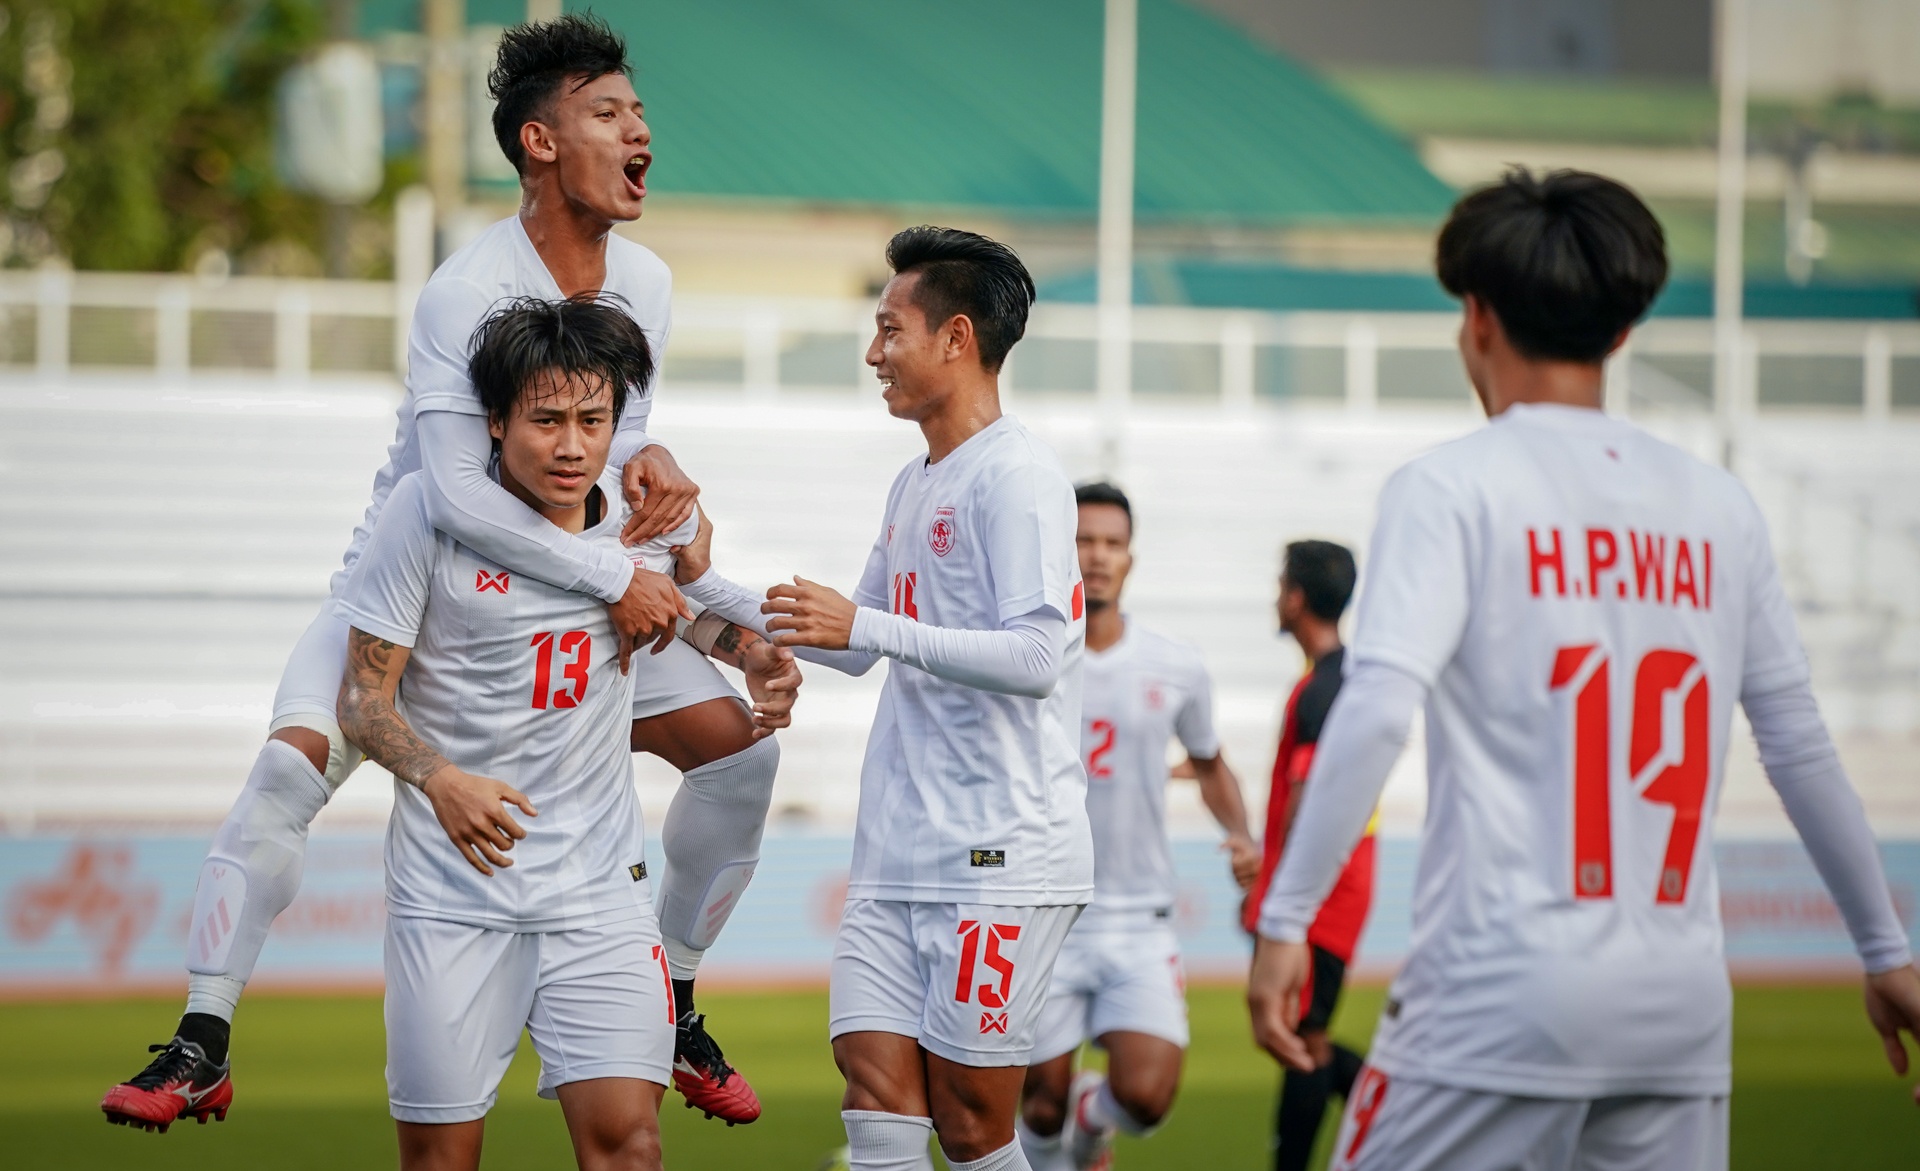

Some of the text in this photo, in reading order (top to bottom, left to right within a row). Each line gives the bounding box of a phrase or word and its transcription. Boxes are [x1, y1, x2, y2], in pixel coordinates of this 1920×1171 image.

[1527, 528, 1713, 611] H.P.WAI
[530, 630, 592, 711] 13
[1088, 718, 1117, 778] 2
[1547, 643, 1710, 905] 19
[651, 944, 676, 1026] 1
[955, 920, 1022, 1009] 15
[1344, 1066, 1390, 1164] 9
